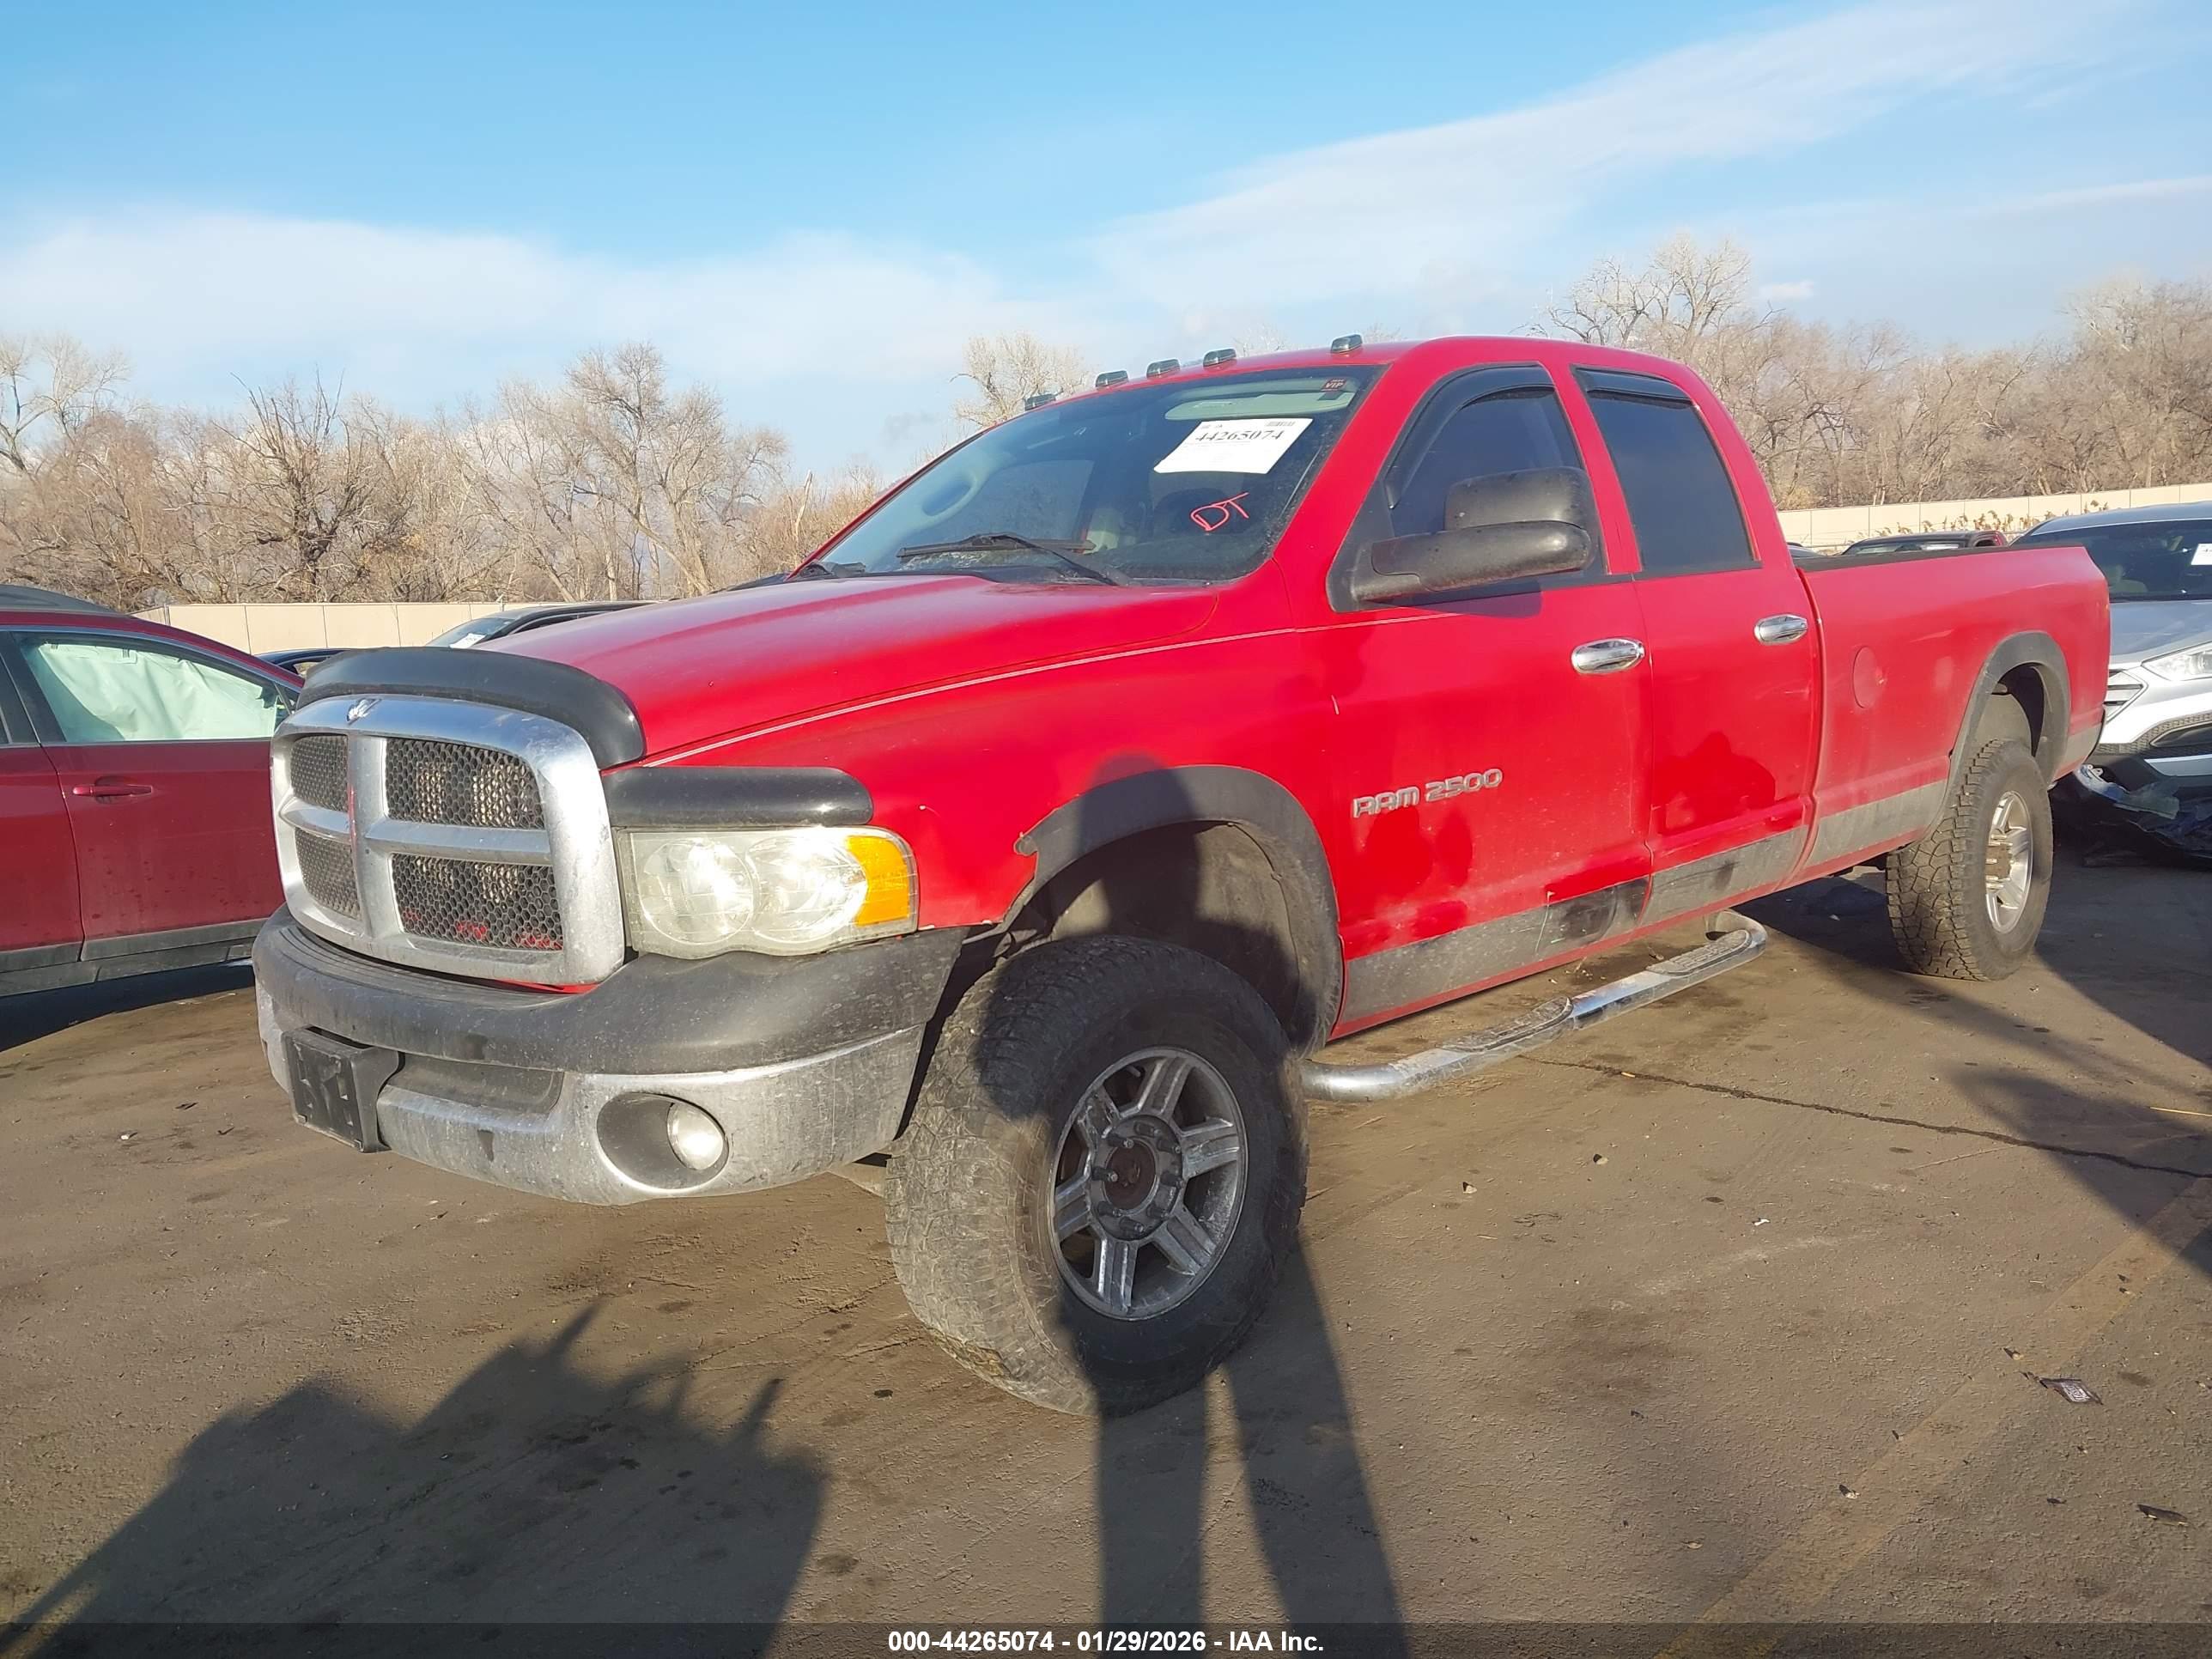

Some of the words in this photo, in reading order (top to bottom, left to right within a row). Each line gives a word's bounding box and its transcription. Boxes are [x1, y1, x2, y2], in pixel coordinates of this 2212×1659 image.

[1194, 430, 1285, 441] 44265074
[1352, 786, 1420, 818] RAM
[1425, 768, 1503, 802] 2500
